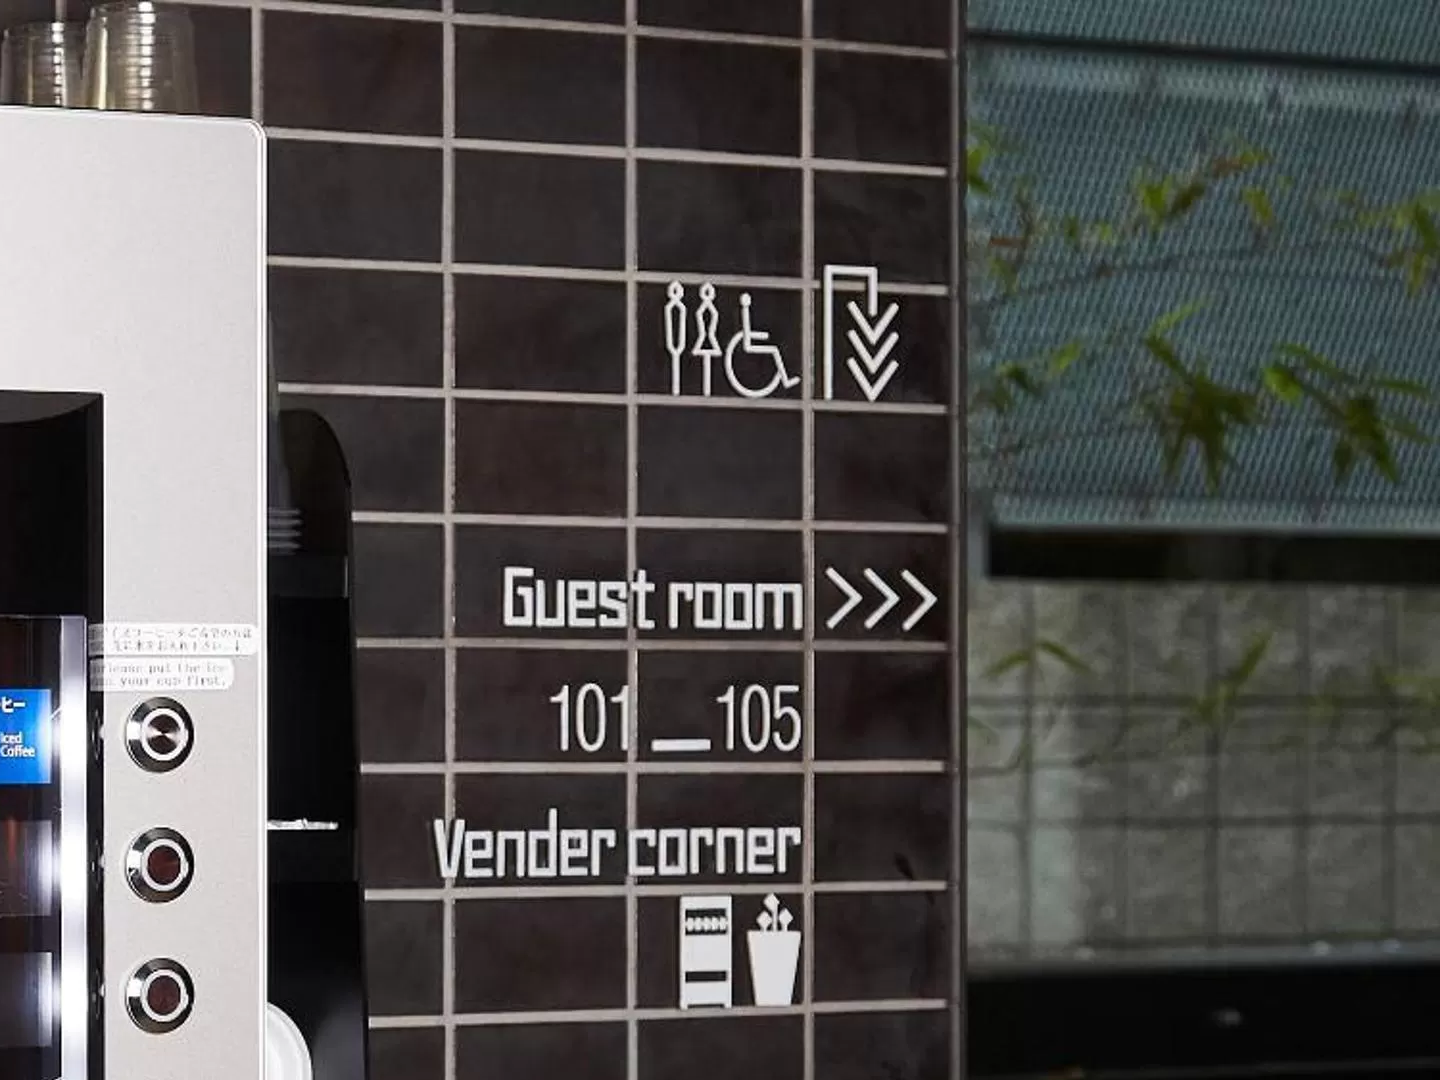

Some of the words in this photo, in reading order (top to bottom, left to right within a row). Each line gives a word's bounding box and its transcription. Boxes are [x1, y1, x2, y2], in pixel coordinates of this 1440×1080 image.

[503, 566, 656, 630] Guest
[669, 582, 803, 630] room
[0, 744, 37, 758] Coffee
[433, 808, 617, 878] Vender
[627, 826, 802, 877] corner
